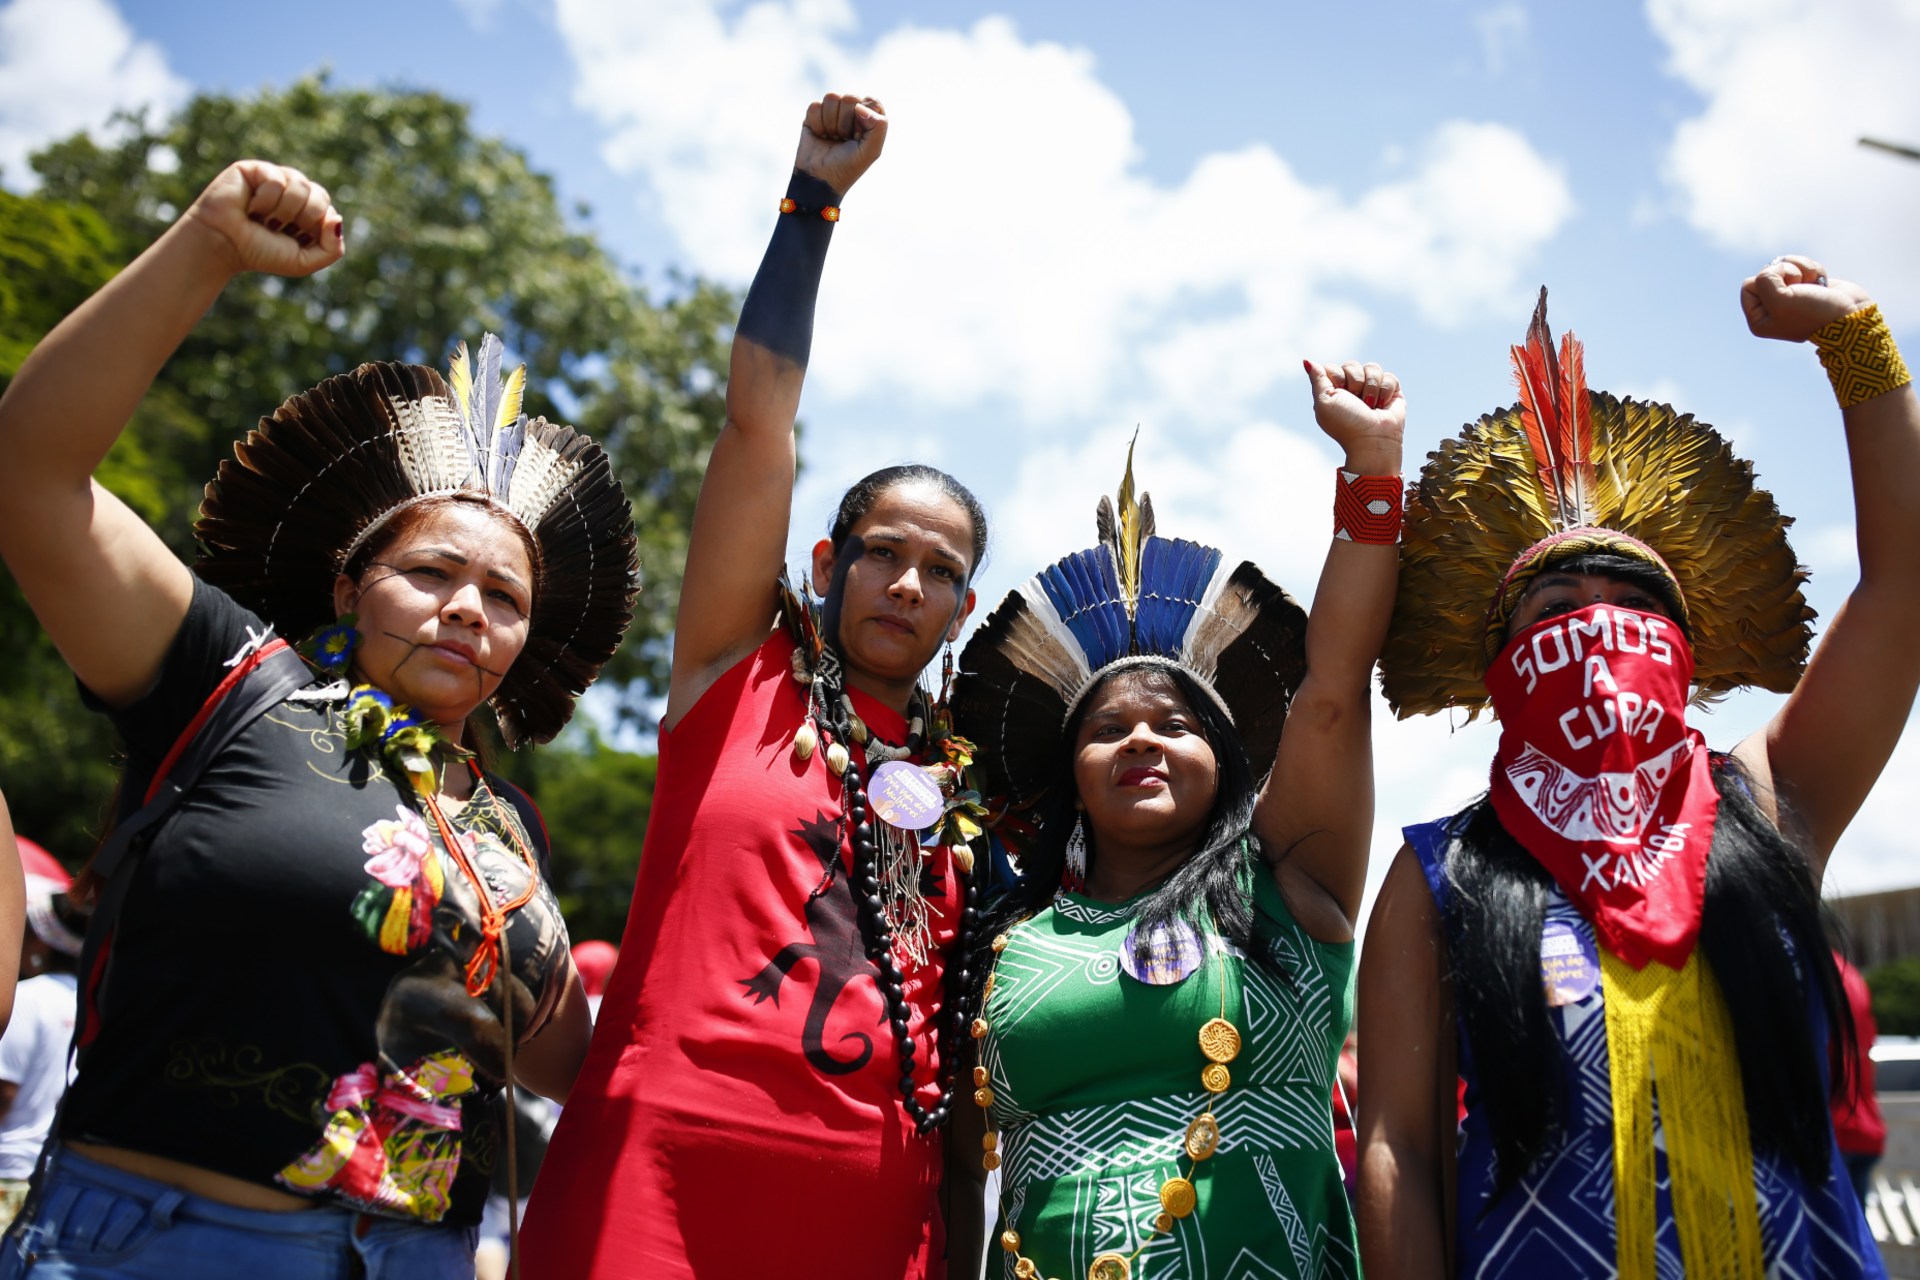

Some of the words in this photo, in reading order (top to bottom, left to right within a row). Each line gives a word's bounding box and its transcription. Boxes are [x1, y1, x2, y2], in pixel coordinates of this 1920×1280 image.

[1511, 609, 1672, 695] SOMOS
[1584, 655, 1618, 698] A
[1559, 692, 1664, 750] CURA
